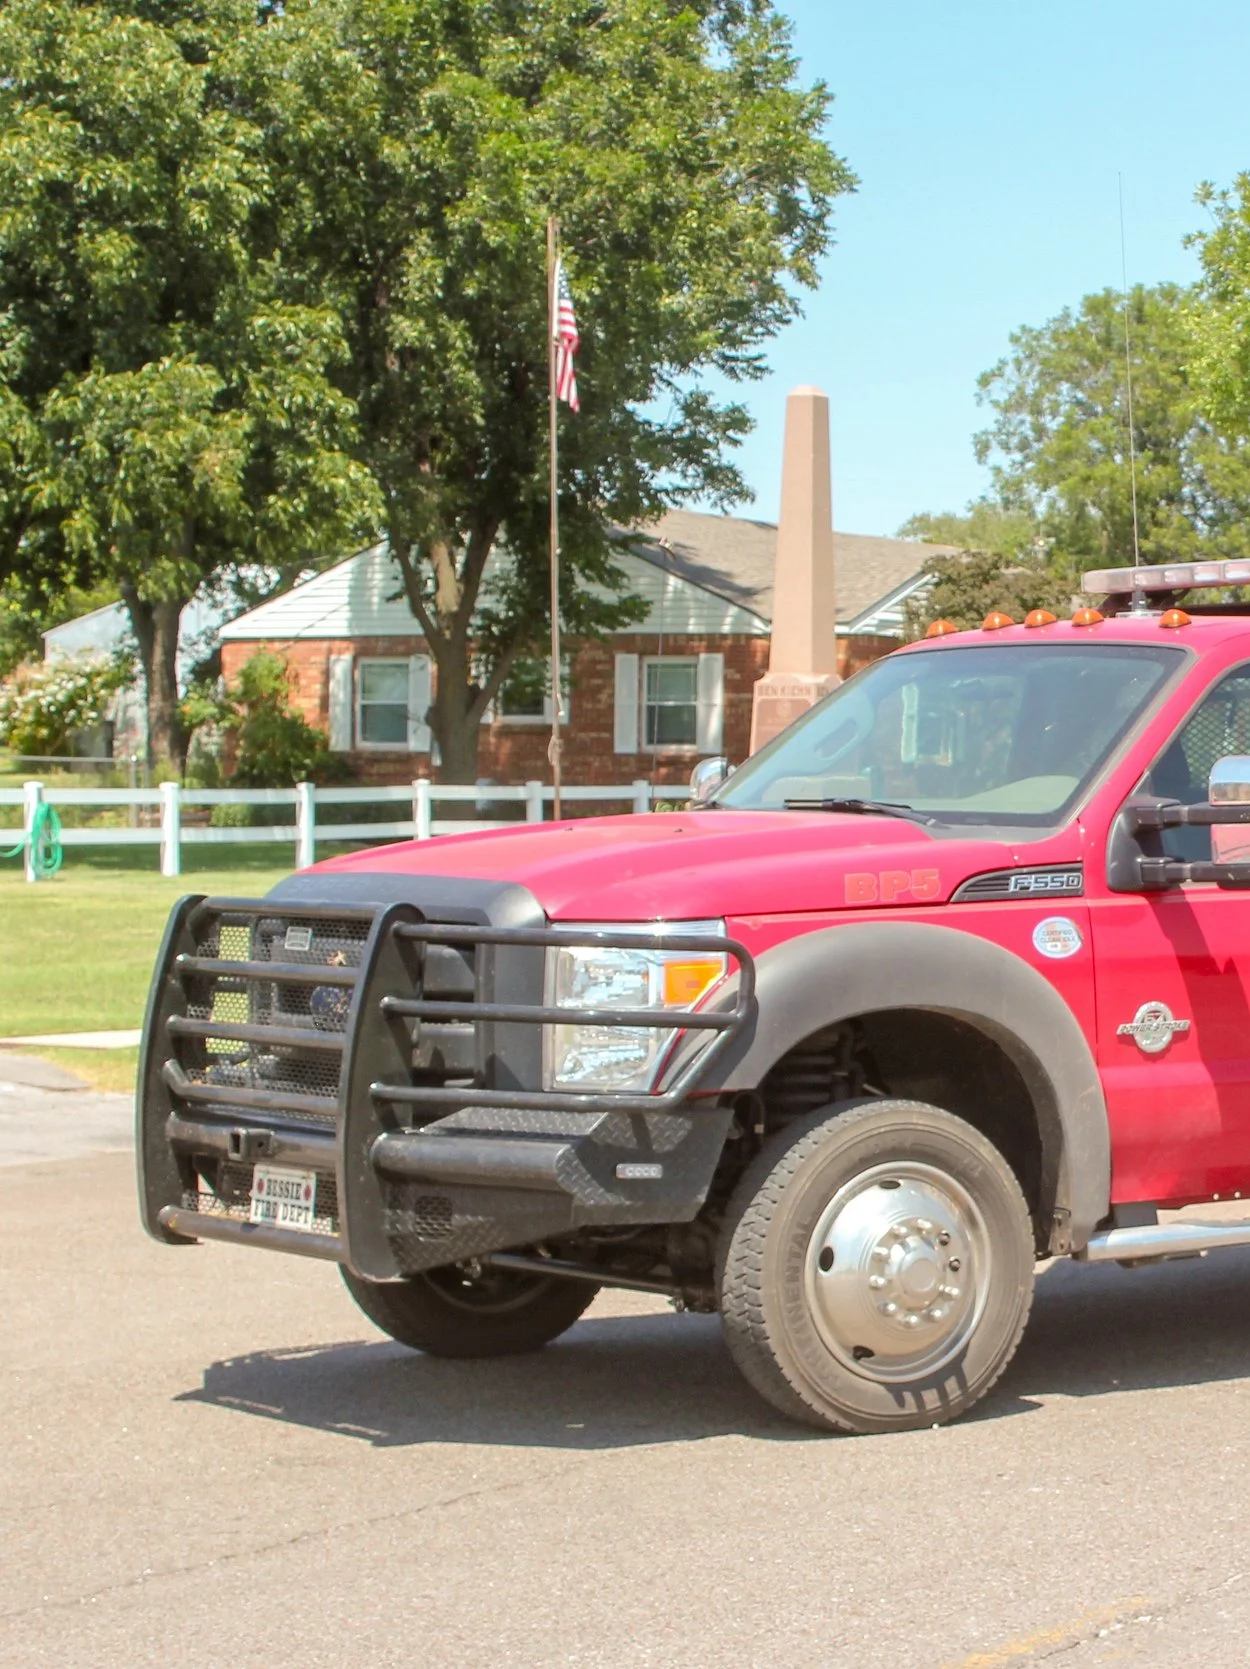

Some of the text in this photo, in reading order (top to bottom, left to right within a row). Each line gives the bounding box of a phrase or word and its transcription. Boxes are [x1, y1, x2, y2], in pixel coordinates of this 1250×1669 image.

[844, 868, 942, 904] BP5
[266, 1178, 303, 1200] BESSIE
[254, 1199, 311, 1225] FIRE DEPT
